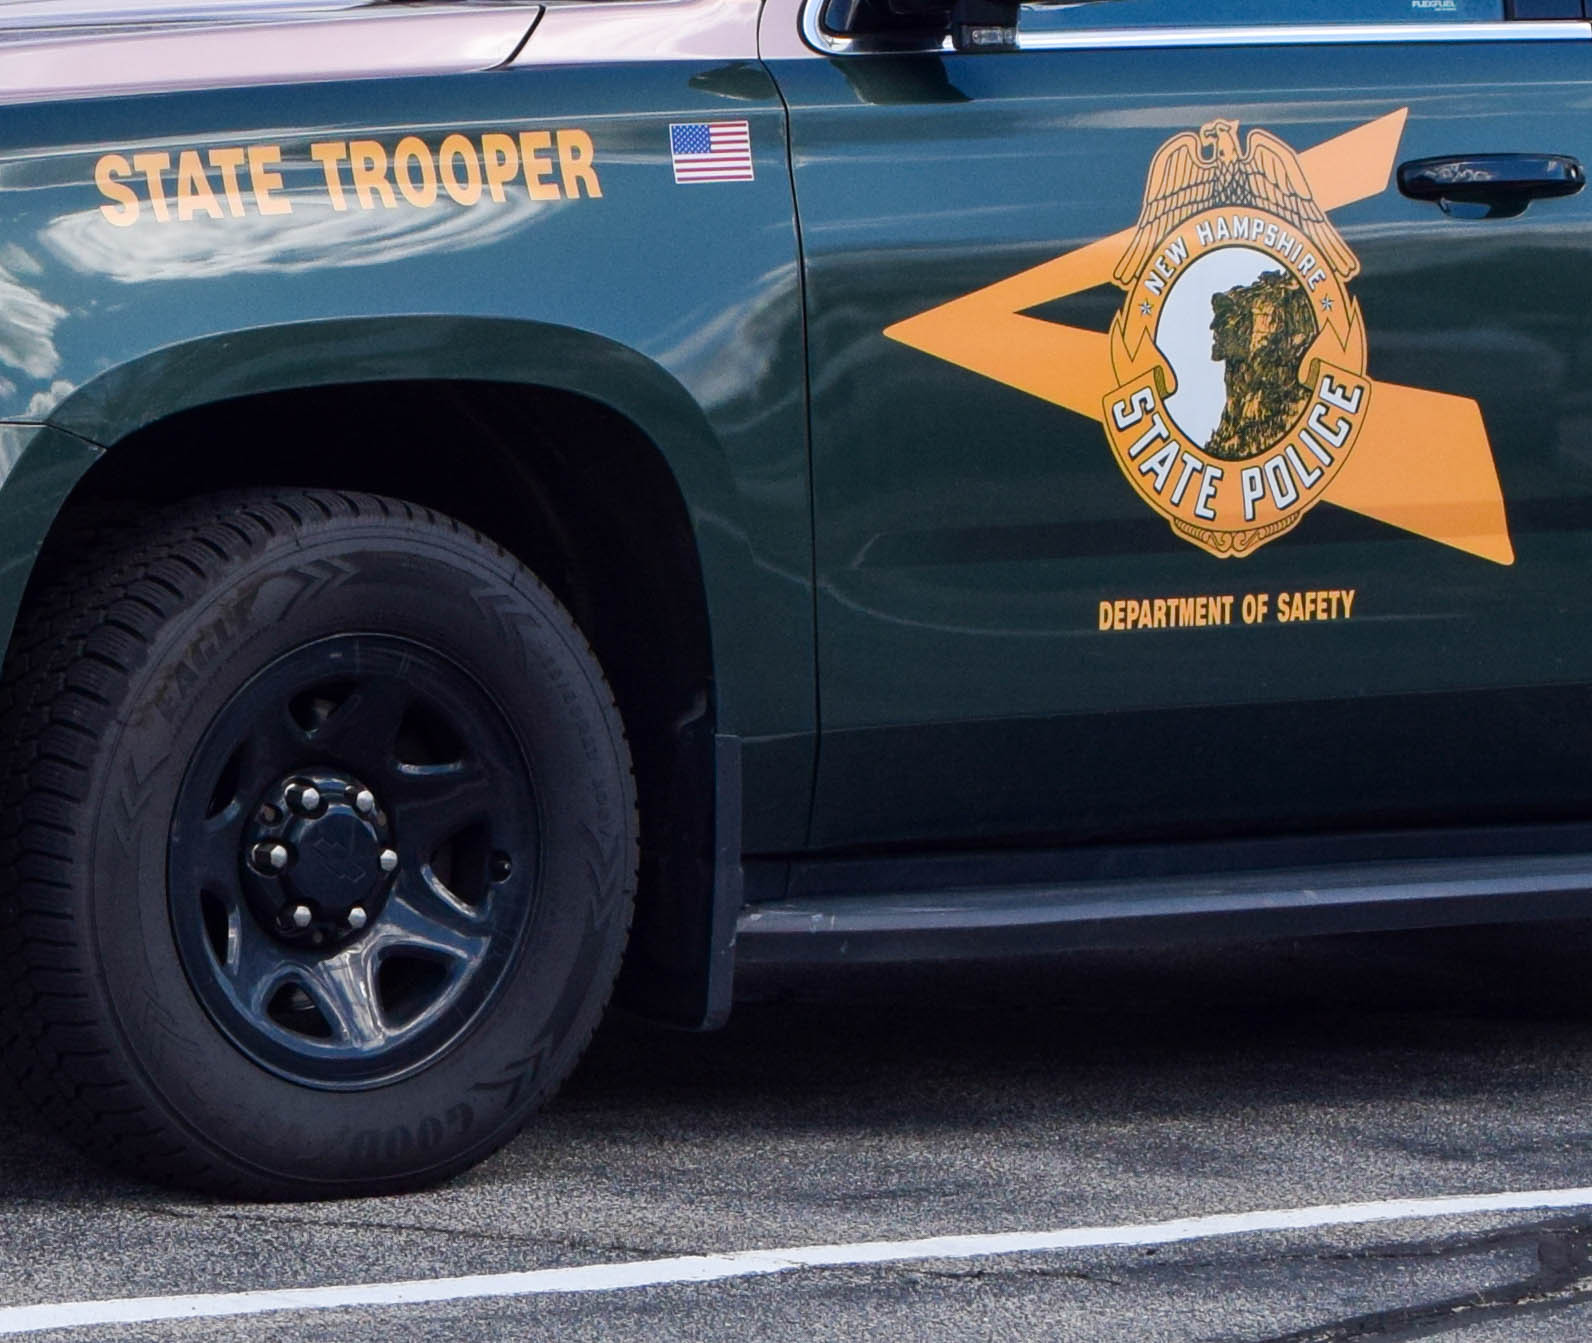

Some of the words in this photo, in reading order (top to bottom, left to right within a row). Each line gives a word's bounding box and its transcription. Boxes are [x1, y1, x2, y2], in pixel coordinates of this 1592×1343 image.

[94, 143, 293, 226] STATE
[310, 127, 603, 212] TROOPER
[1144, 236, 1189, 296] NEW
[1196, 215, 1327, 291] HAMPSHIRE
[1112, 386, 1224, 521] STATE
[1241, 375, 1364, 521] POLICE
[1098, 595, 1234, 632] DEPARTMENT
[1241, 592, 1269, 625] OF
[1277, 588, 1355, 623] SAFETY
